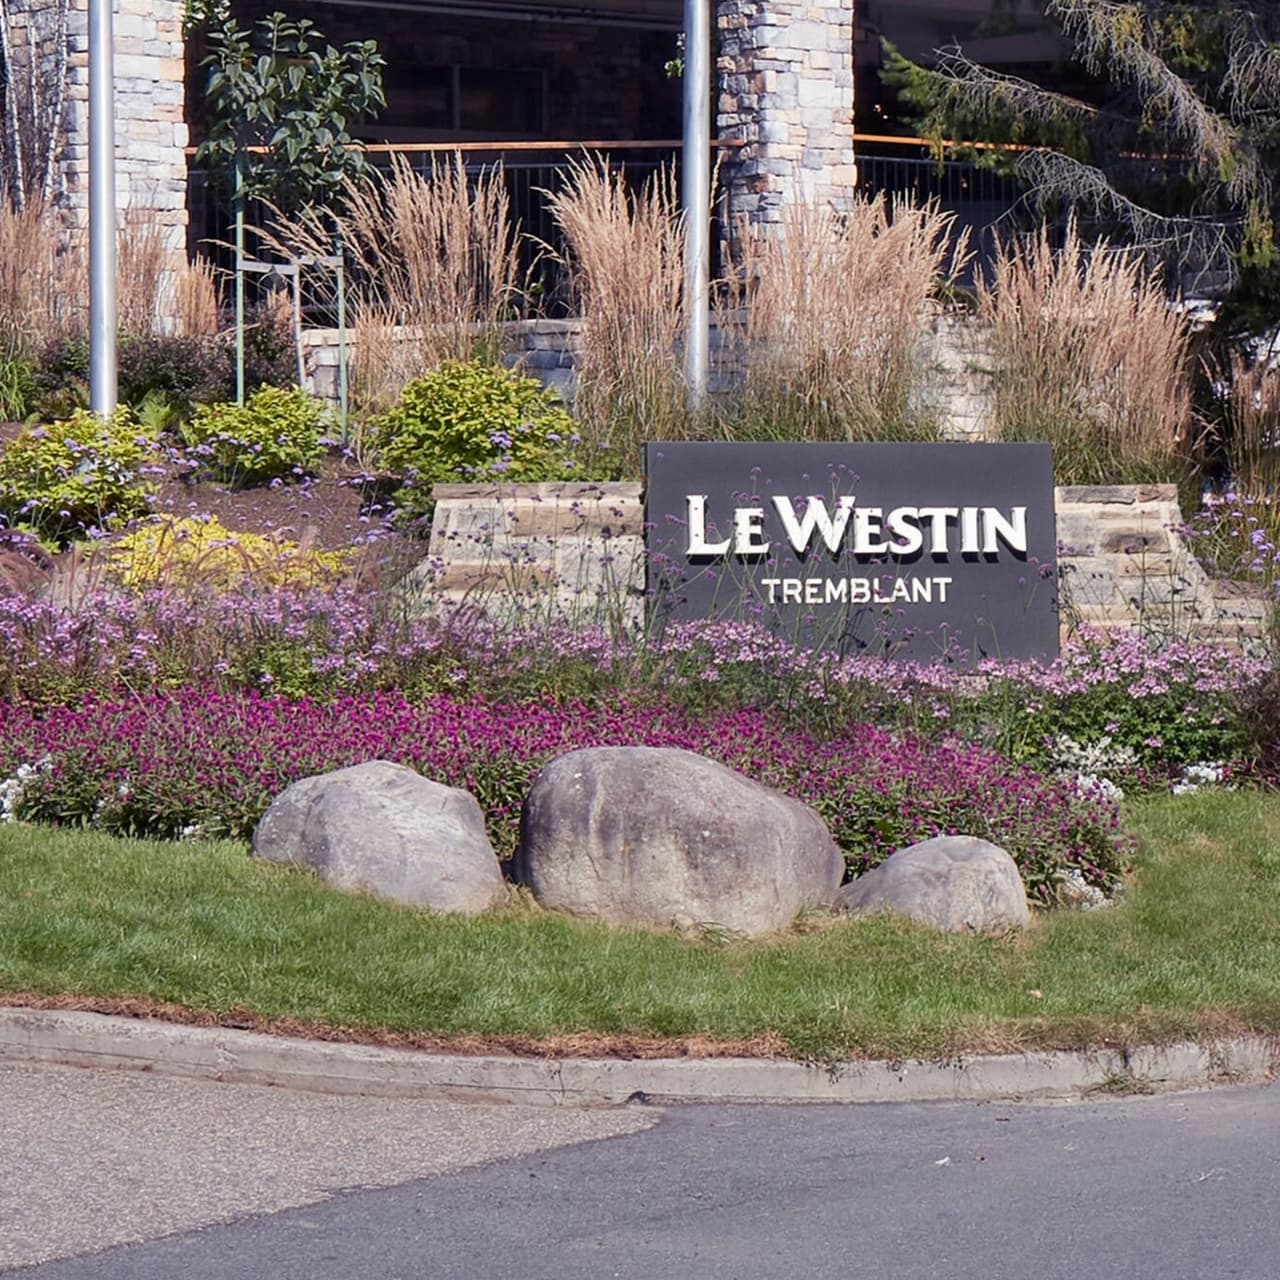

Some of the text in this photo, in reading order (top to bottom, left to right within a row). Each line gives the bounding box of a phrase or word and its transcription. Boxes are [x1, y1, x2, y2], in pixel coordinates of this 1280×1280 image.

[685, 495, 1027, 554] LE WESTIN
[761, 576, 952, 604] TREMBLANT
